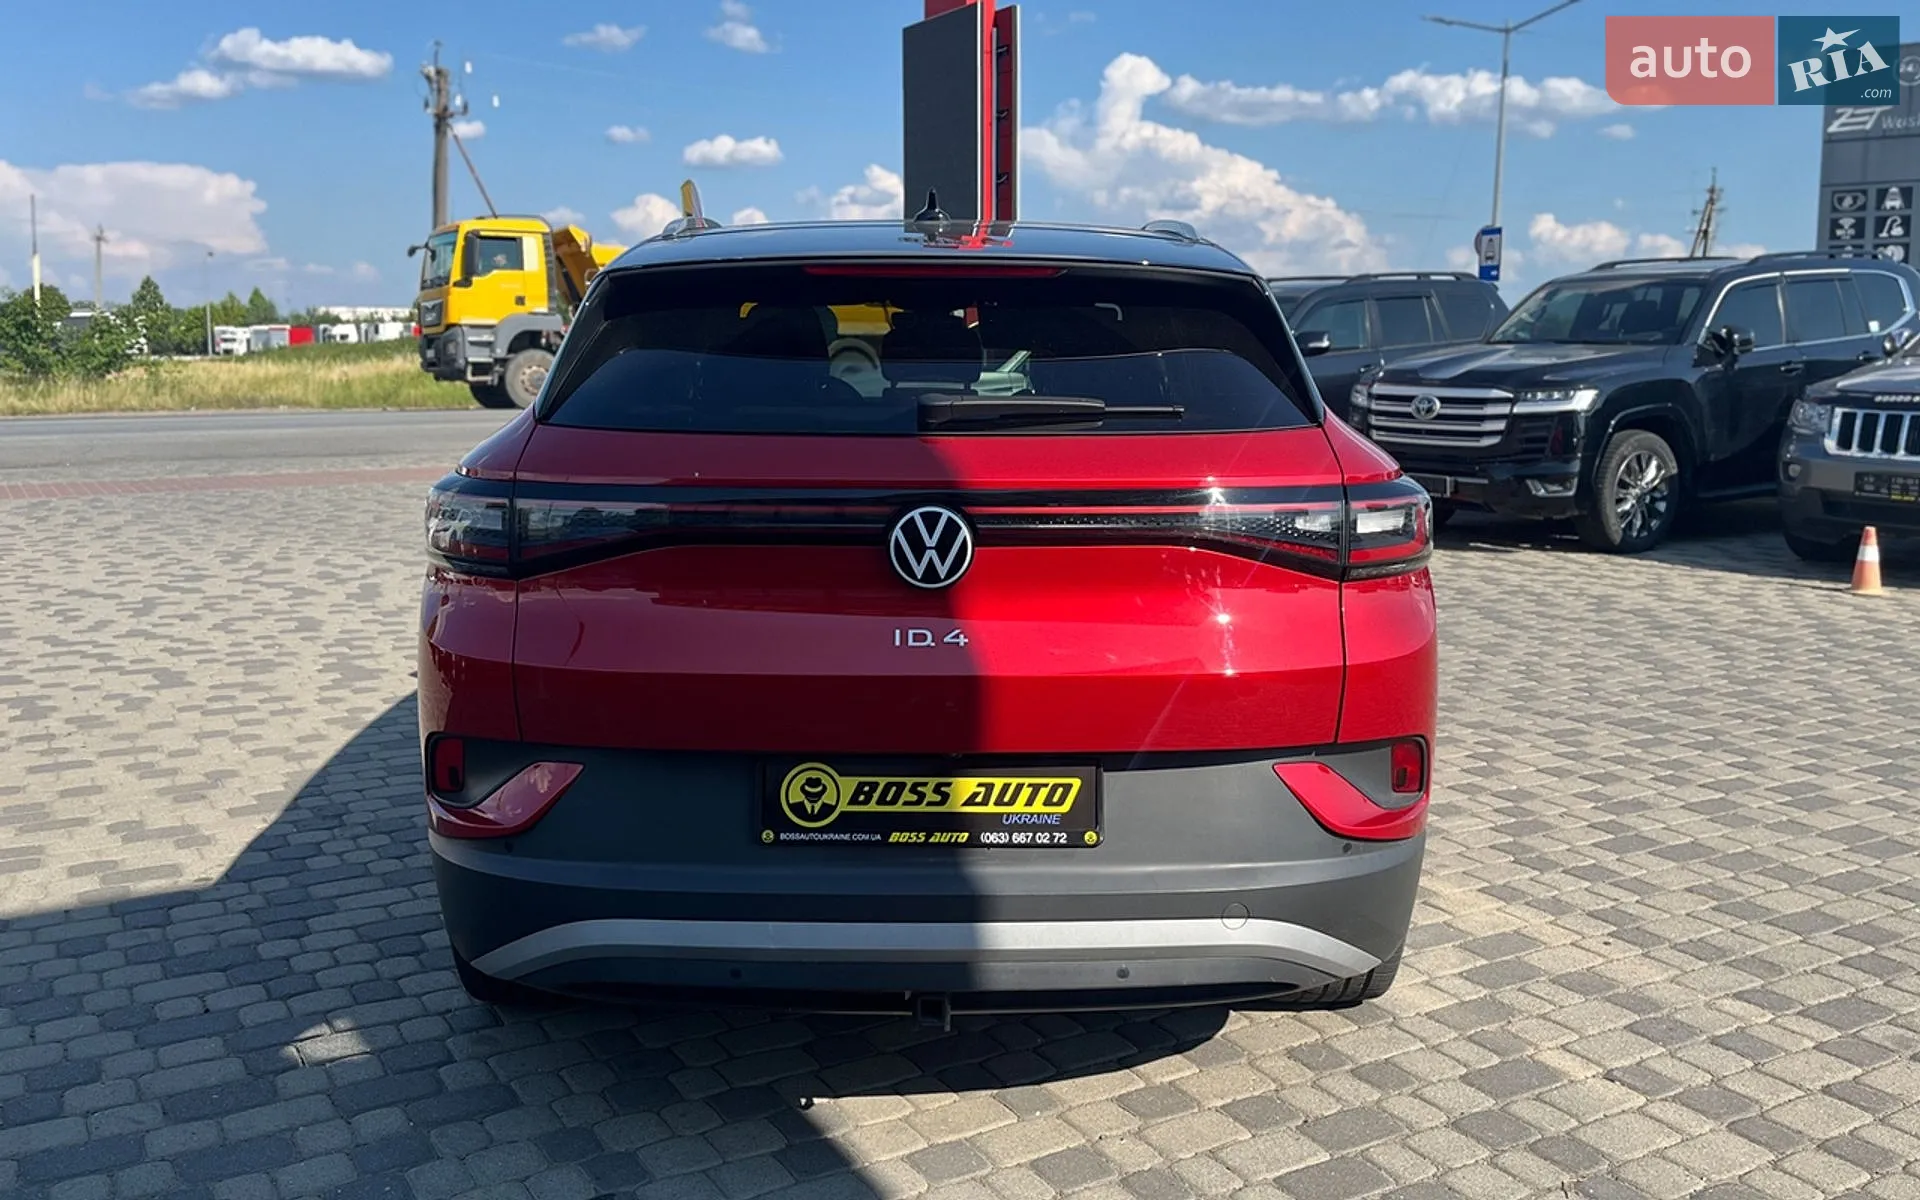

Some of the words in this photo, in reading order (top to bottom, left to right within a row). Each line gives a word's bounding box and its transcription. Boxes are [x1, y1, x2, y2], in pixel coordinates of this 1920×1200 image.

[848, 781, 953, 808] BOSS
[960, 781, 1075, 808] AUTO
[1002, 814, 1062, 825] UKRAINE
[888, 832, 926, 843] BOSS
[928, 832, 970, 843] AUTO
[980, 832, 1009, 844] (063)
[1012, 832, 1032, 844] 667
[1035, 832, 1050, 844] 02
[1053, 832, 1068, 844] 72
